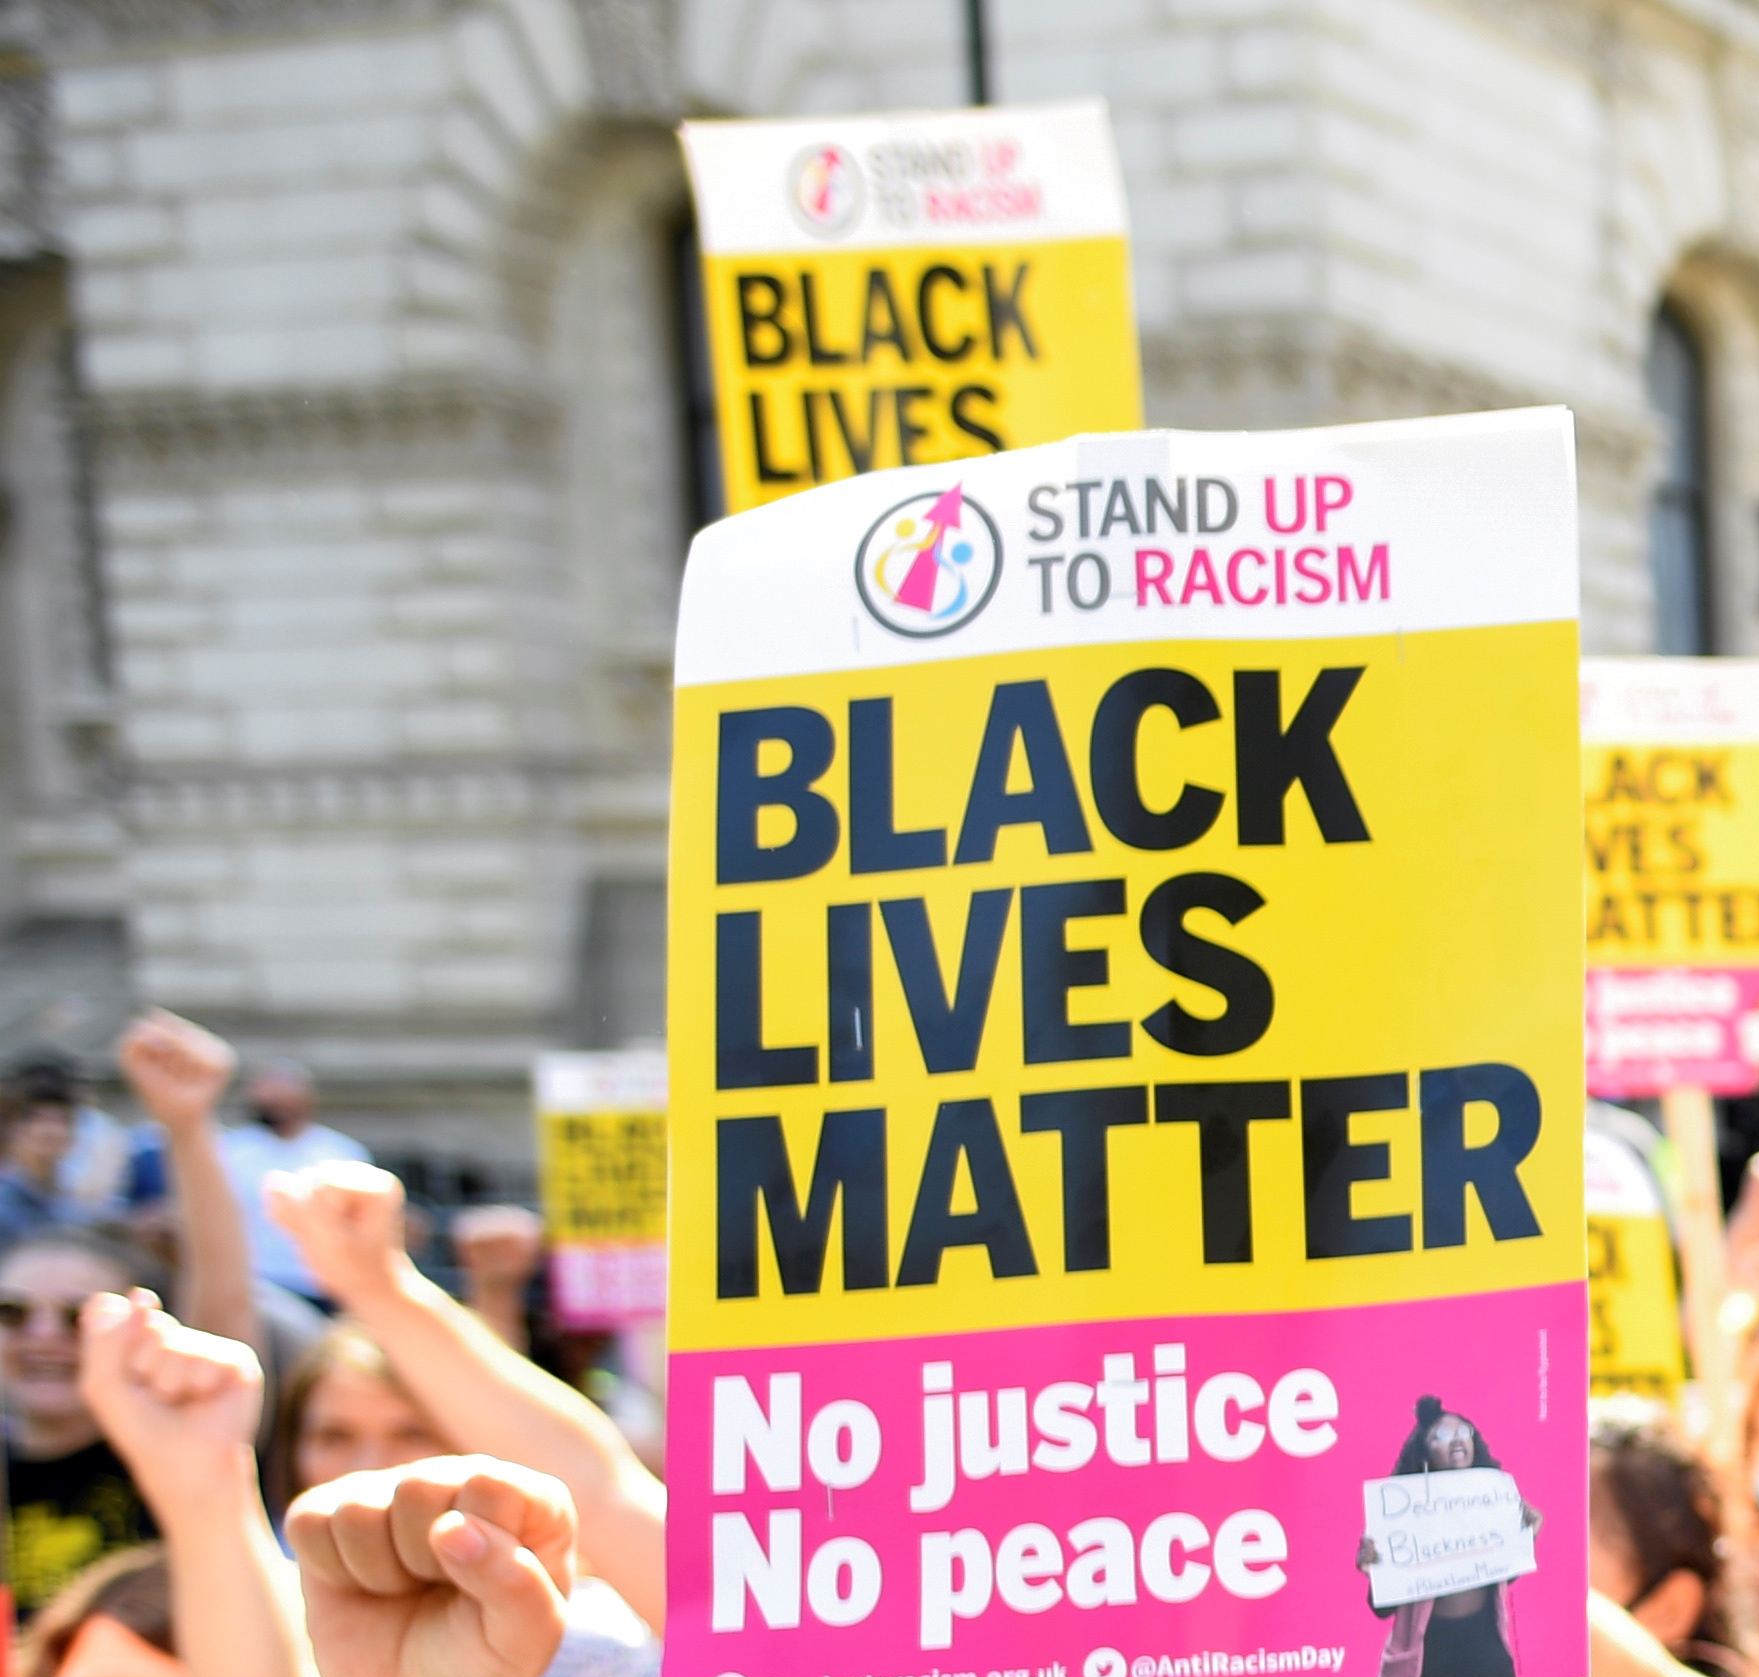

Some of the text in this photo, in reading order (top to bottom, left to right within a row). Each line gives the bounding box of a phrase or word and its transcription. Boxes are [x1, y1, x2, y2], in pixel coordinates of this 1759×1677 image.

[736, 261, 1041, 367] BLACK
[749, 384, 1008, 484] LIVES
[1028, 475, 1354, 542] STAND UP
[1028, 543, 1391, 614] TO RACISM
[716, 666, 1371, 886] BLACK
[715, 872, 1274, 1091] LIVES
[716, 1063, 1543, 1300] MATTER
[711, 1343, 1339, 1513] No justice
[711, 1509, 1289, 1651] No peace
[1388, 1529, 1506, 1567] Blackness
